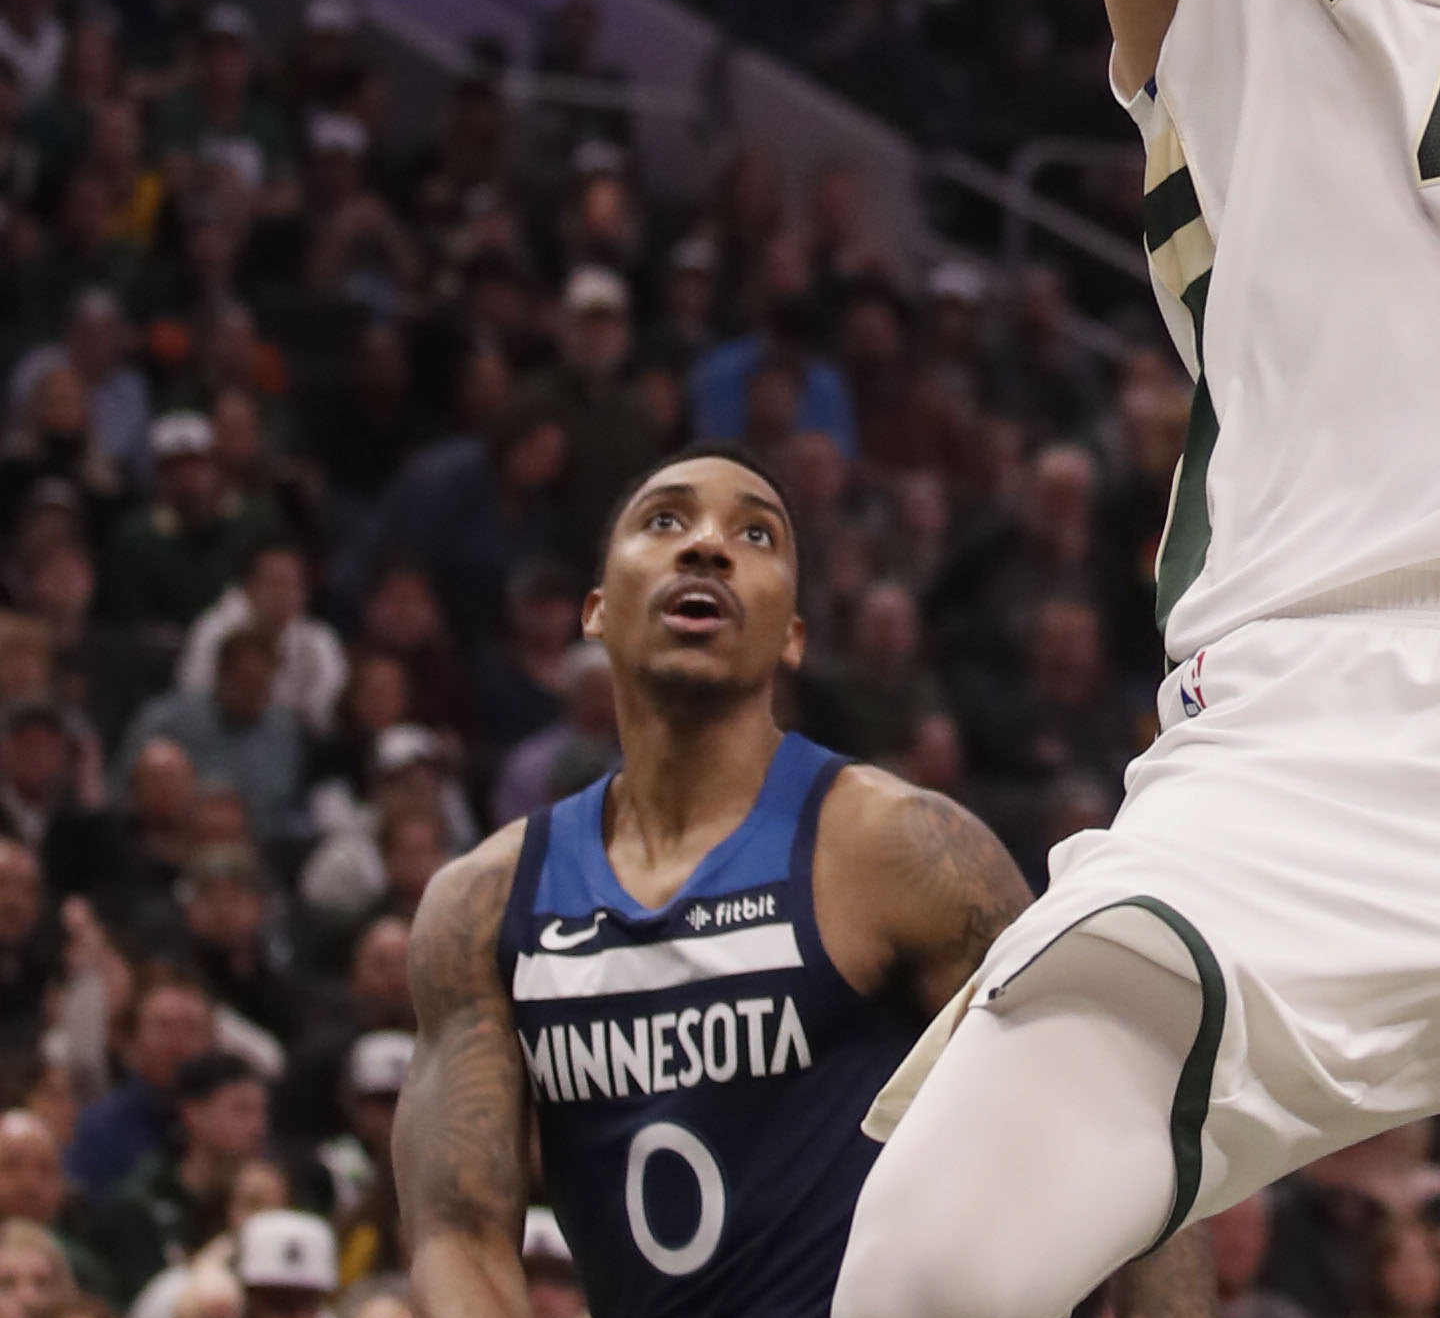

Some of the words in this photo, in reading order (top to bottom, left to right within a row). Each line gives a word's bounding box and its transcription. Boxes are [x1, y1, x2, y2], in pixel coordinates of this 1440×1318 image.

[715, 894, 776, 928] fitbit
[518, 995, 812, 1104] MINNESOTA
[626, 1121, 726, 1276] 0
